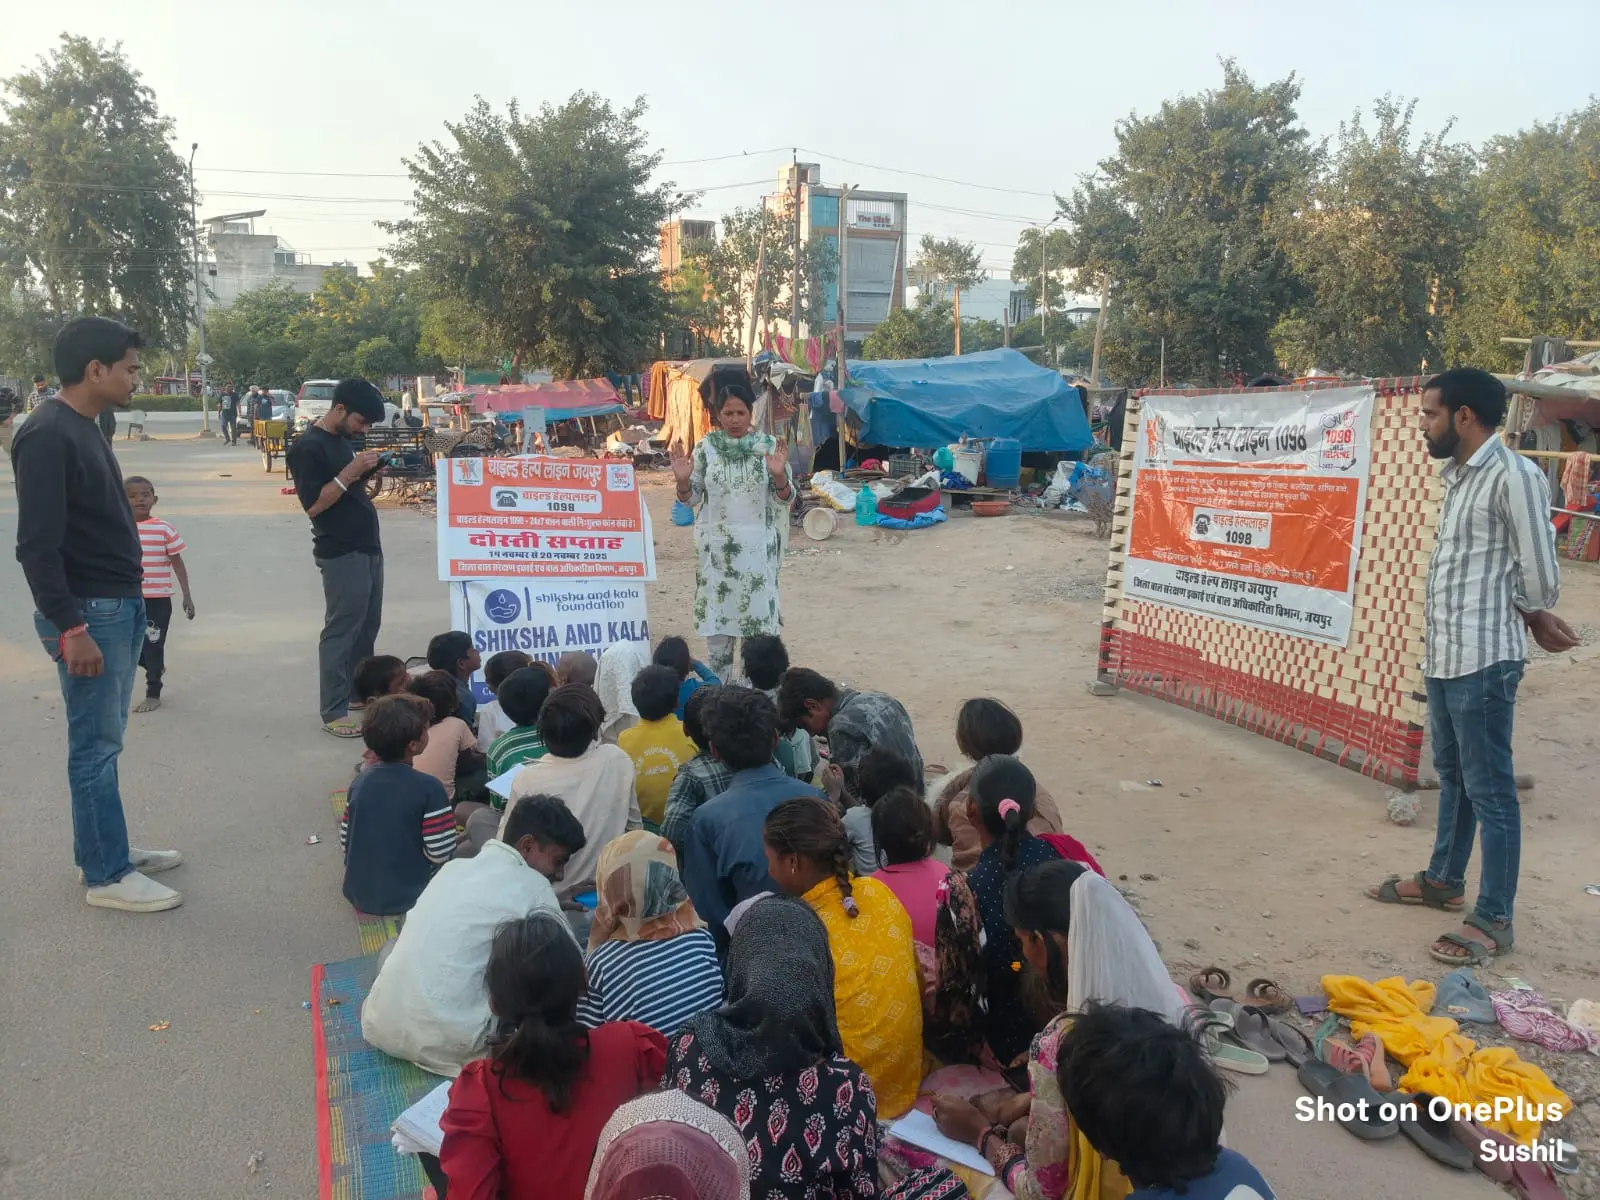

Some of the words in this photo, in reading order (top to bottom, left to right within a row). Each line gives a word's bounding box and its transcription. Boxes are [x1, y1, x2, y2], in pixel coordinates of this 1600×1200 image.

[1275, 424, 1307, 451] 1098
[1326, 429, 1352, 444] 1098
[488, 459, 519, 478] चाइल्ड
[521, 457, 542, 479] हेल्प
[544, 462, 570, 480] लाइन
[572, 464, 602, 487] जयपुर
[522, 490, 551, 501] चाइल्ड
[552, 489, 597, 503] हेल्पलाइन
[547, 502, 575, 512] 1098
[1213, 514, 1233, 528] चाइल्ड
[1235, 512, 1269, 532] हेल्पलाइन
[468, 531, 542, 549] दोस्ती
[546, 535, 624, 550] सप्ताह
[1225, 530, 1252, 545] 1098
[541, 551, 551, 560] 20
[584, 552, 608, 560] 2025
[1201, 572, 1219, 588] हेल्प
[1221, 577, 1245, 593] लाइन
[1247, 583, 1278, 601] जयपुर
[535, 592, 584, 604] shiksha
[588, 589, 611, 601] and
[613, 588, 639, 599] kala
[1133, 576, 1150, 590] जिला
[1150, 580, 1163, 592] बाल
[1163, 582, 1186, 598] संरक्षण
[1187, 587, 1204, 602] इकाई
[1205, 590, 1216, 603] एवं
[1216, 595, 1231, 607] बाल
[1232, 597, 1274, 616] अधिकारिता
[1275, 603, 1303, 623] विभाग,
[1304, 611, 1333, 628] जयपुर
[556, 599, 625, 613] foundation
[475, 625, 560, 652] SHIKSHA
[565, 622, 601, 646] AND
[607, 619, 650, 643] KALA
